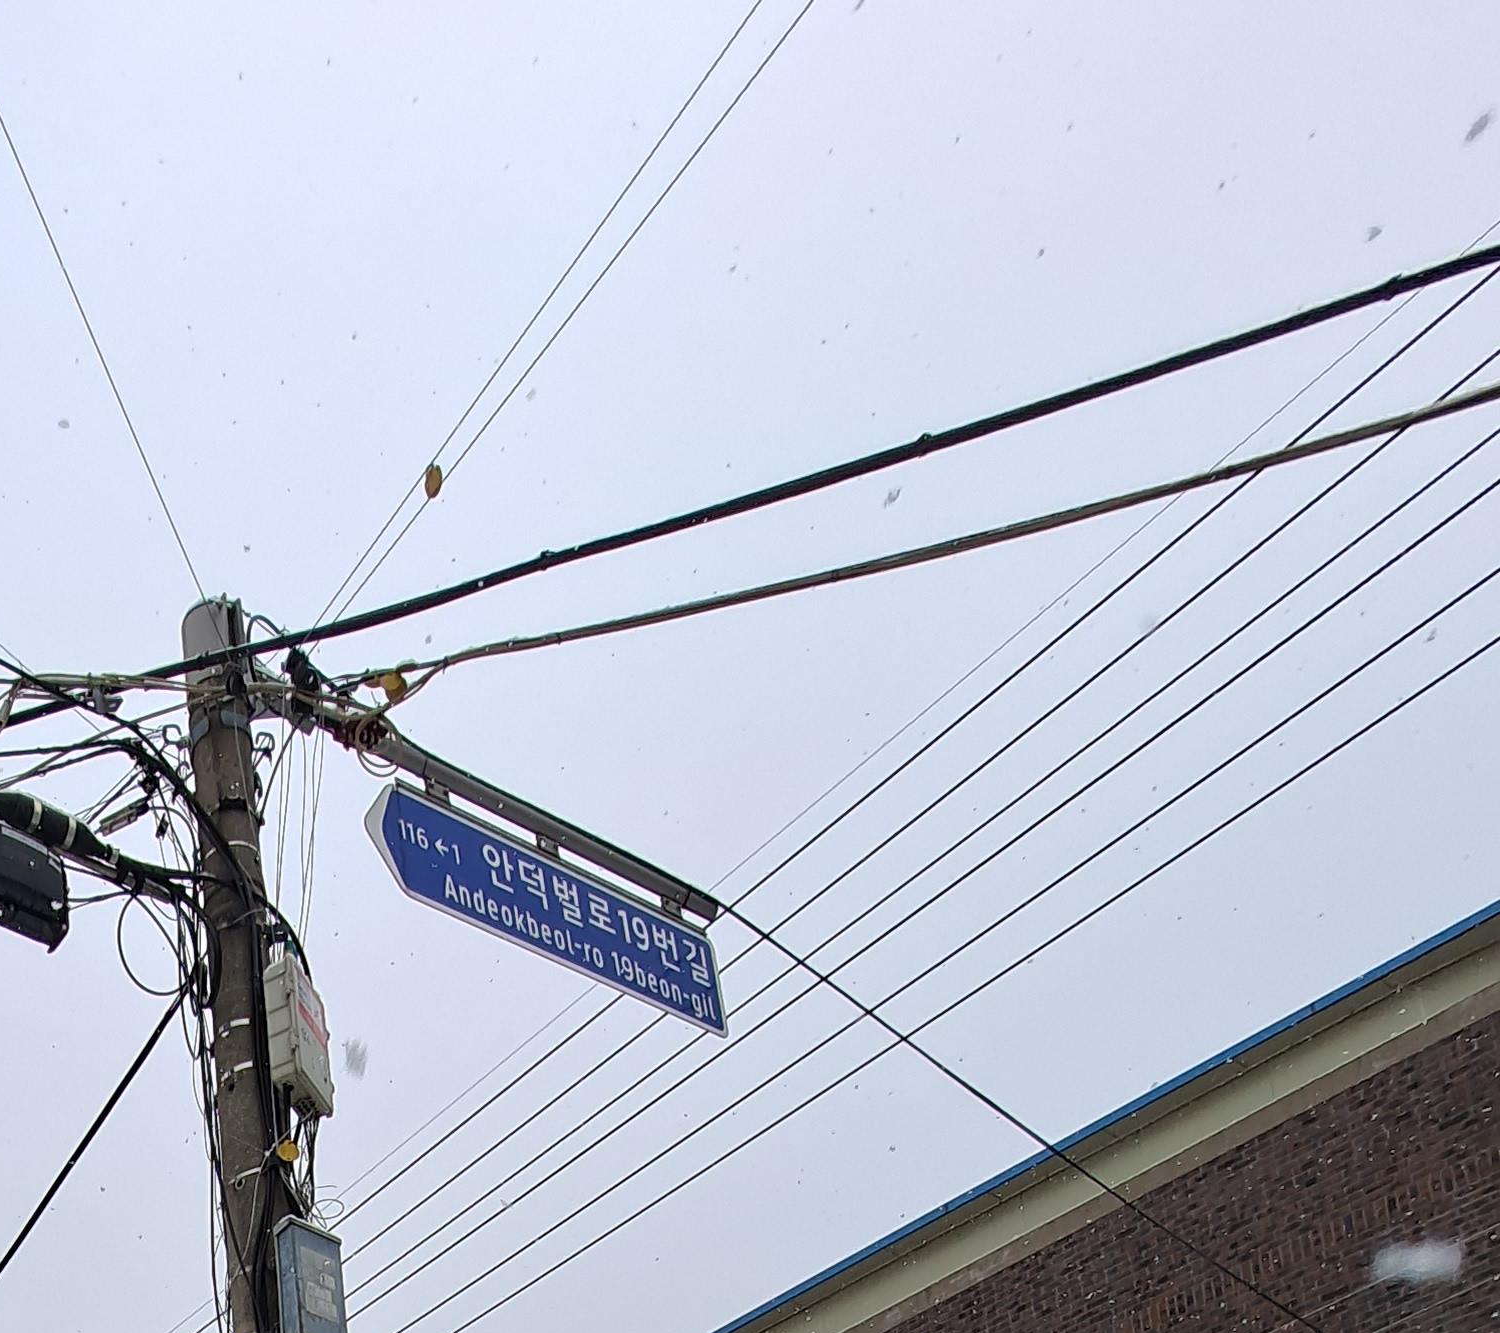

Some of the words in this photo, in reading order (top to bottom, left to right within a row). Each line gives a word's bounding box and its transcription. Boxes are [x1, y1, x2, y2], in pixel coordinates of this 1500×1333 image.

[398, 818, 429, 852] 116
[445, 873, 604, 969] Andeokbeol-ro
[612, 950, 717, 1022] 19beon-gil
[482, 843, 711, 988] 안덕벌로19번길
